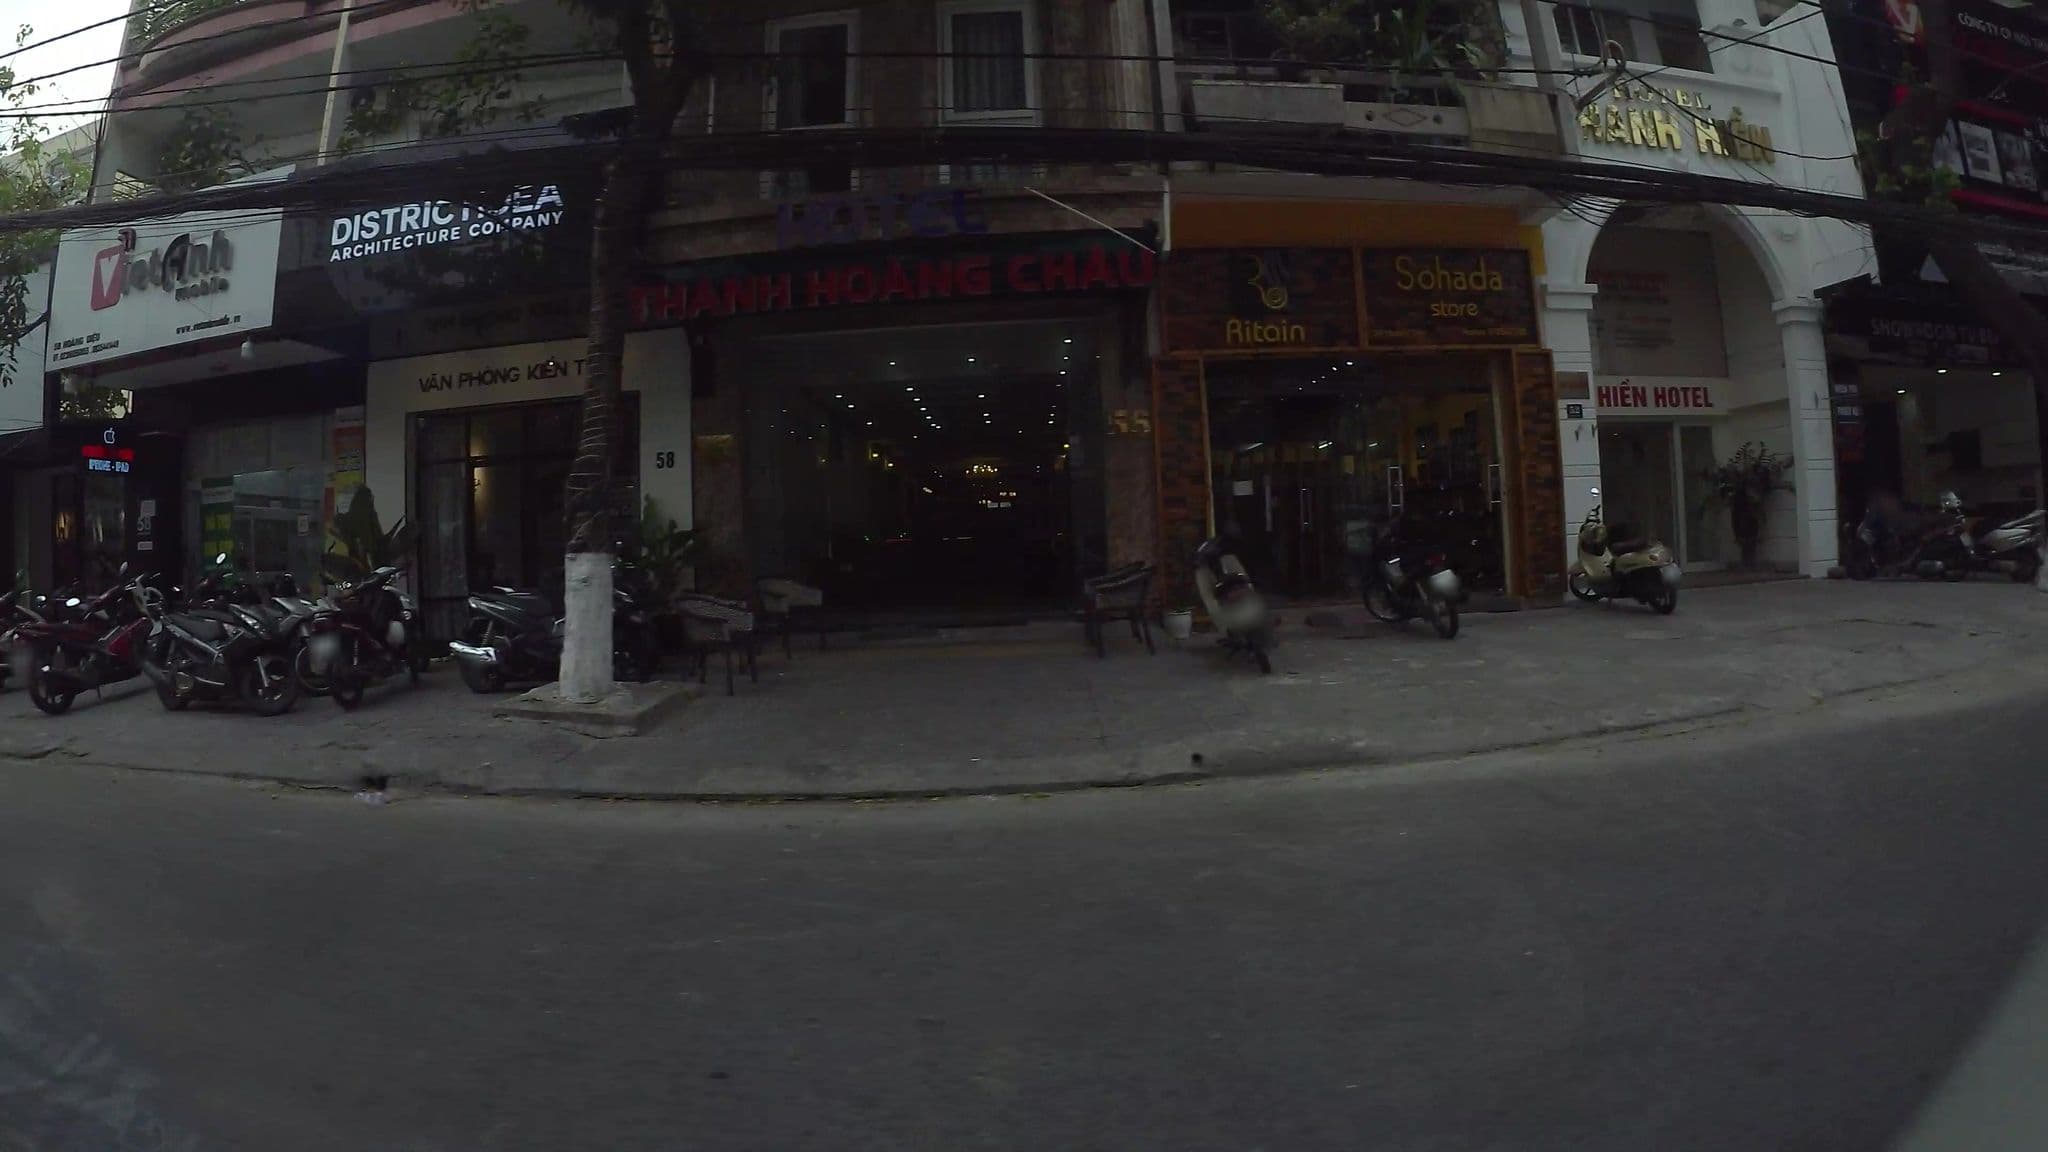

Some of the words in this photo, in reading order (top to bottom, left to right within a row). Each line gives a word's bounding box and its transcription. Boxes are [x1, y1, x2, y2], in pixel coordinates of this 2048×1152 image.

[329, 227, 461, 262] ARCHITECTURE
[469, 211, 563, 237] COMPANY
[1395, 255, 1503, 291] Sohada
[631, 271, 794, 324] THANH
[1431, 300, 1479, 317] store
[419, 373, 452, 393] VĂN
[458, 365, 520, 389] PHÒNG
[528, 356, 567, 380] KIẾN
[1598, 378, 1648, 408] HIỀN
[1653, 386, 1713, 408] HOTEL
[656, 451, 675, 469] 58
